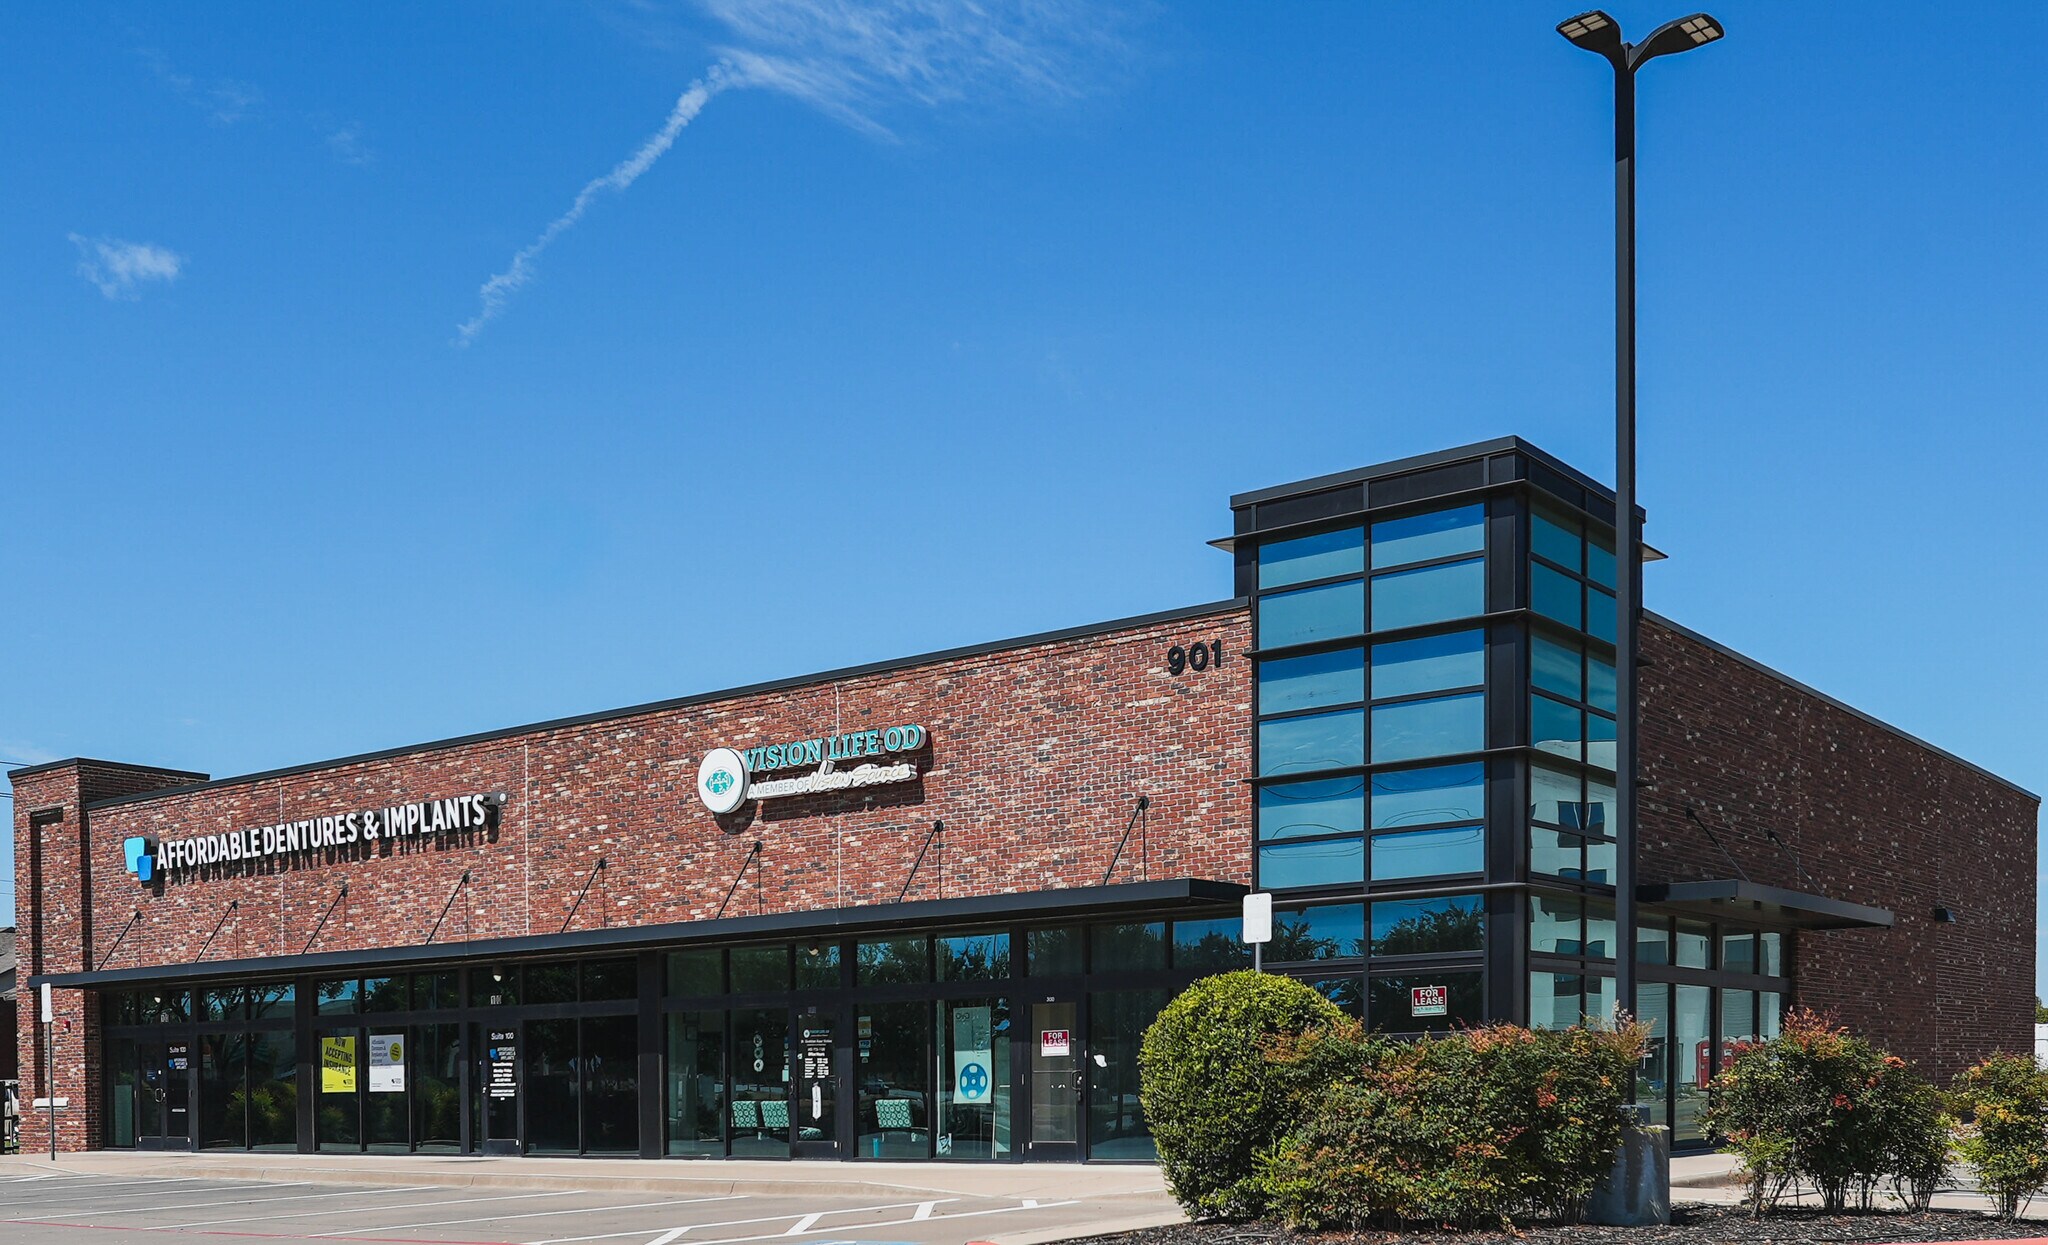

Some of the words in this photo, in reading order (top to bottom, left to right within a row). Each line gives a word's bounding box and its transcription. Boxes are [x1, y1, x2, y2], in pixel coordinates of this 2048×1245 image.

[1168, 639, 1222, 676] 901
[743, 738, 823, 771] VISION
[828, 729, 879, 760] LIFE
[884, 724, 920, 752] OD
[749, 784, 756, 796] A
[757, 778, 796, 794] MEMBER
[797, 778, 809, 791] OF
[156, 828, 261, 871] AFFORDABLE
[263, 812, 358, 855] DENTURES
[363, 810, 380, 841] &
[384, 794, 486, 838] IMPLANTS
[1415, 996, 1444, 1005] LEASE
[1420, 989, 1439, 997] FOR
[1043, 1038, 1068, 1047] LEASE
[1048, 1032, 1063, 1040] FOR
[325, 1046, 353, 1064] ACCEPTING
